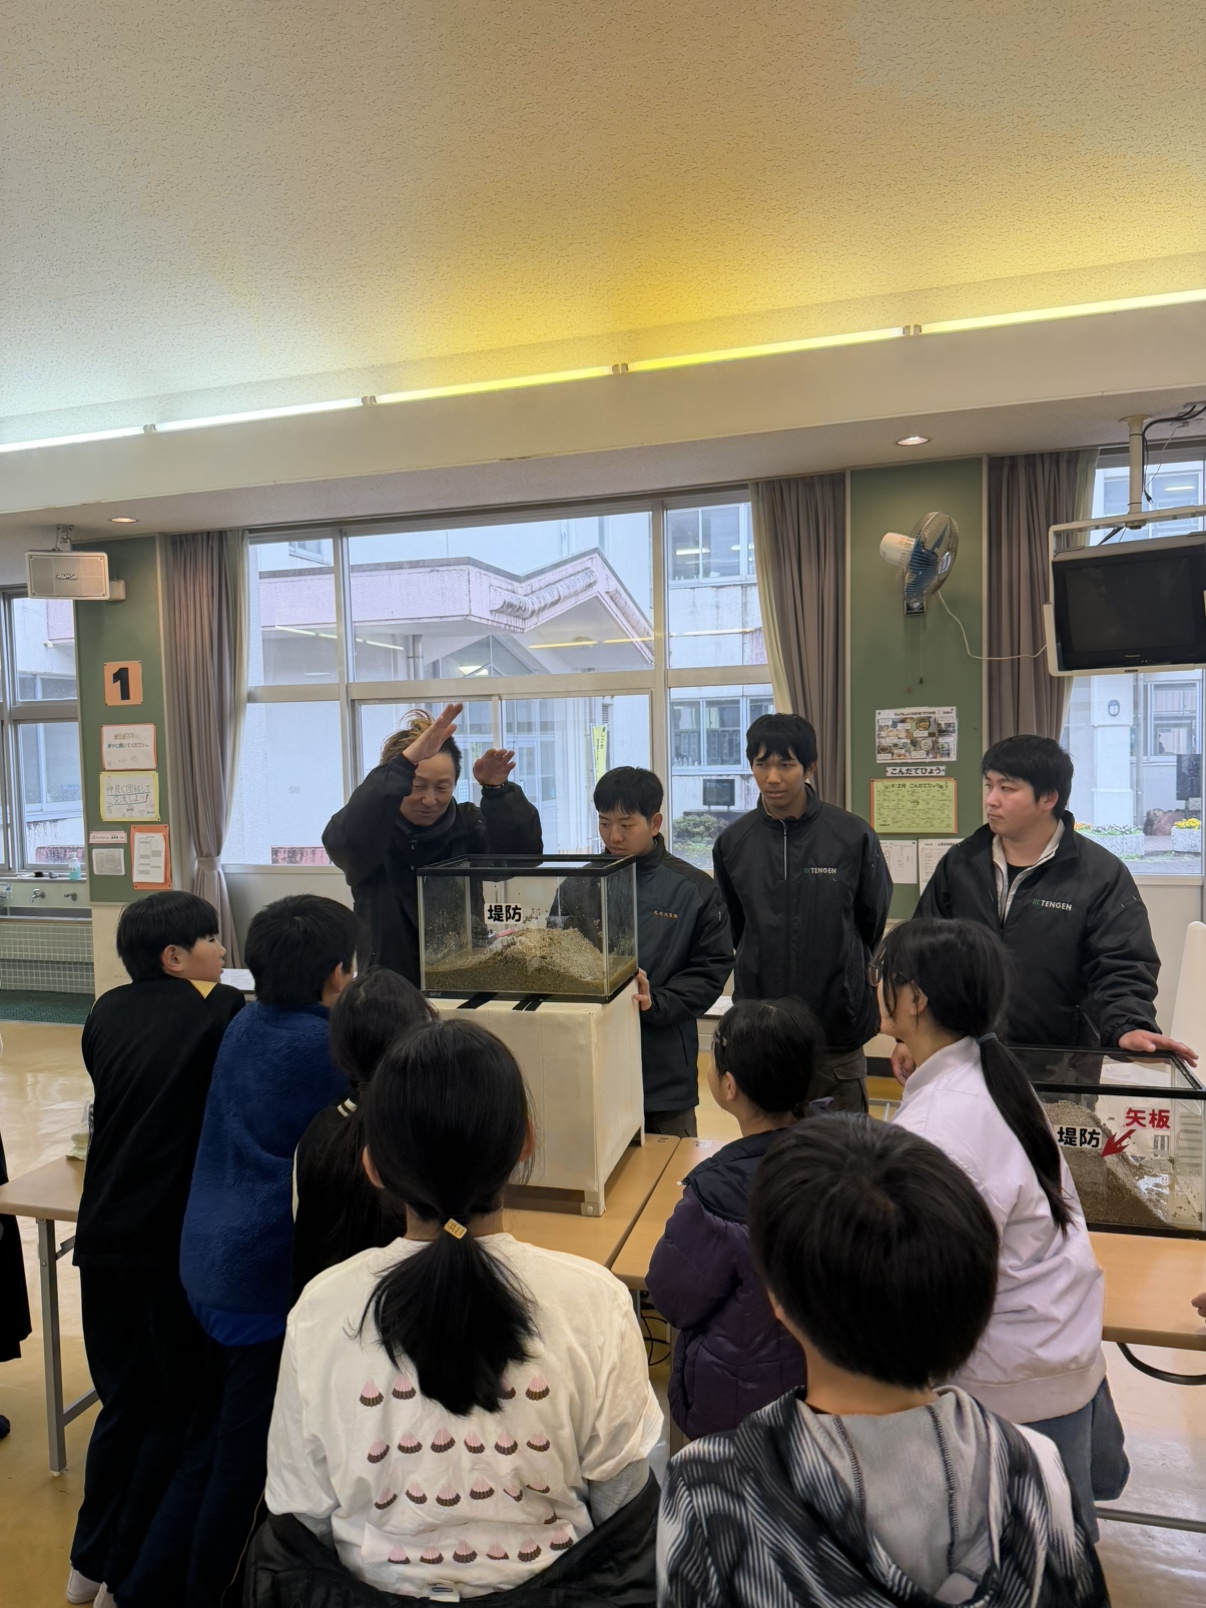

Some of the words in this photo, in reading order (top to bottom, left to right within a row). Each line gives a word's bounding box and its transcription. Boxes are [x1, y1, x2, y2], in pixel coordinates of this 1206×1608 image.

[112, 667, 131, 701] 1
[890, 767, 942, 775] こんだてひょう
[487, 904, 522, 922] 堤防
[1041, 899, 1072, 911] TENGEN
[1125, 1107, 1171, 1129] 矢板
[1057, 1126, 1101, 1148] 堤防
